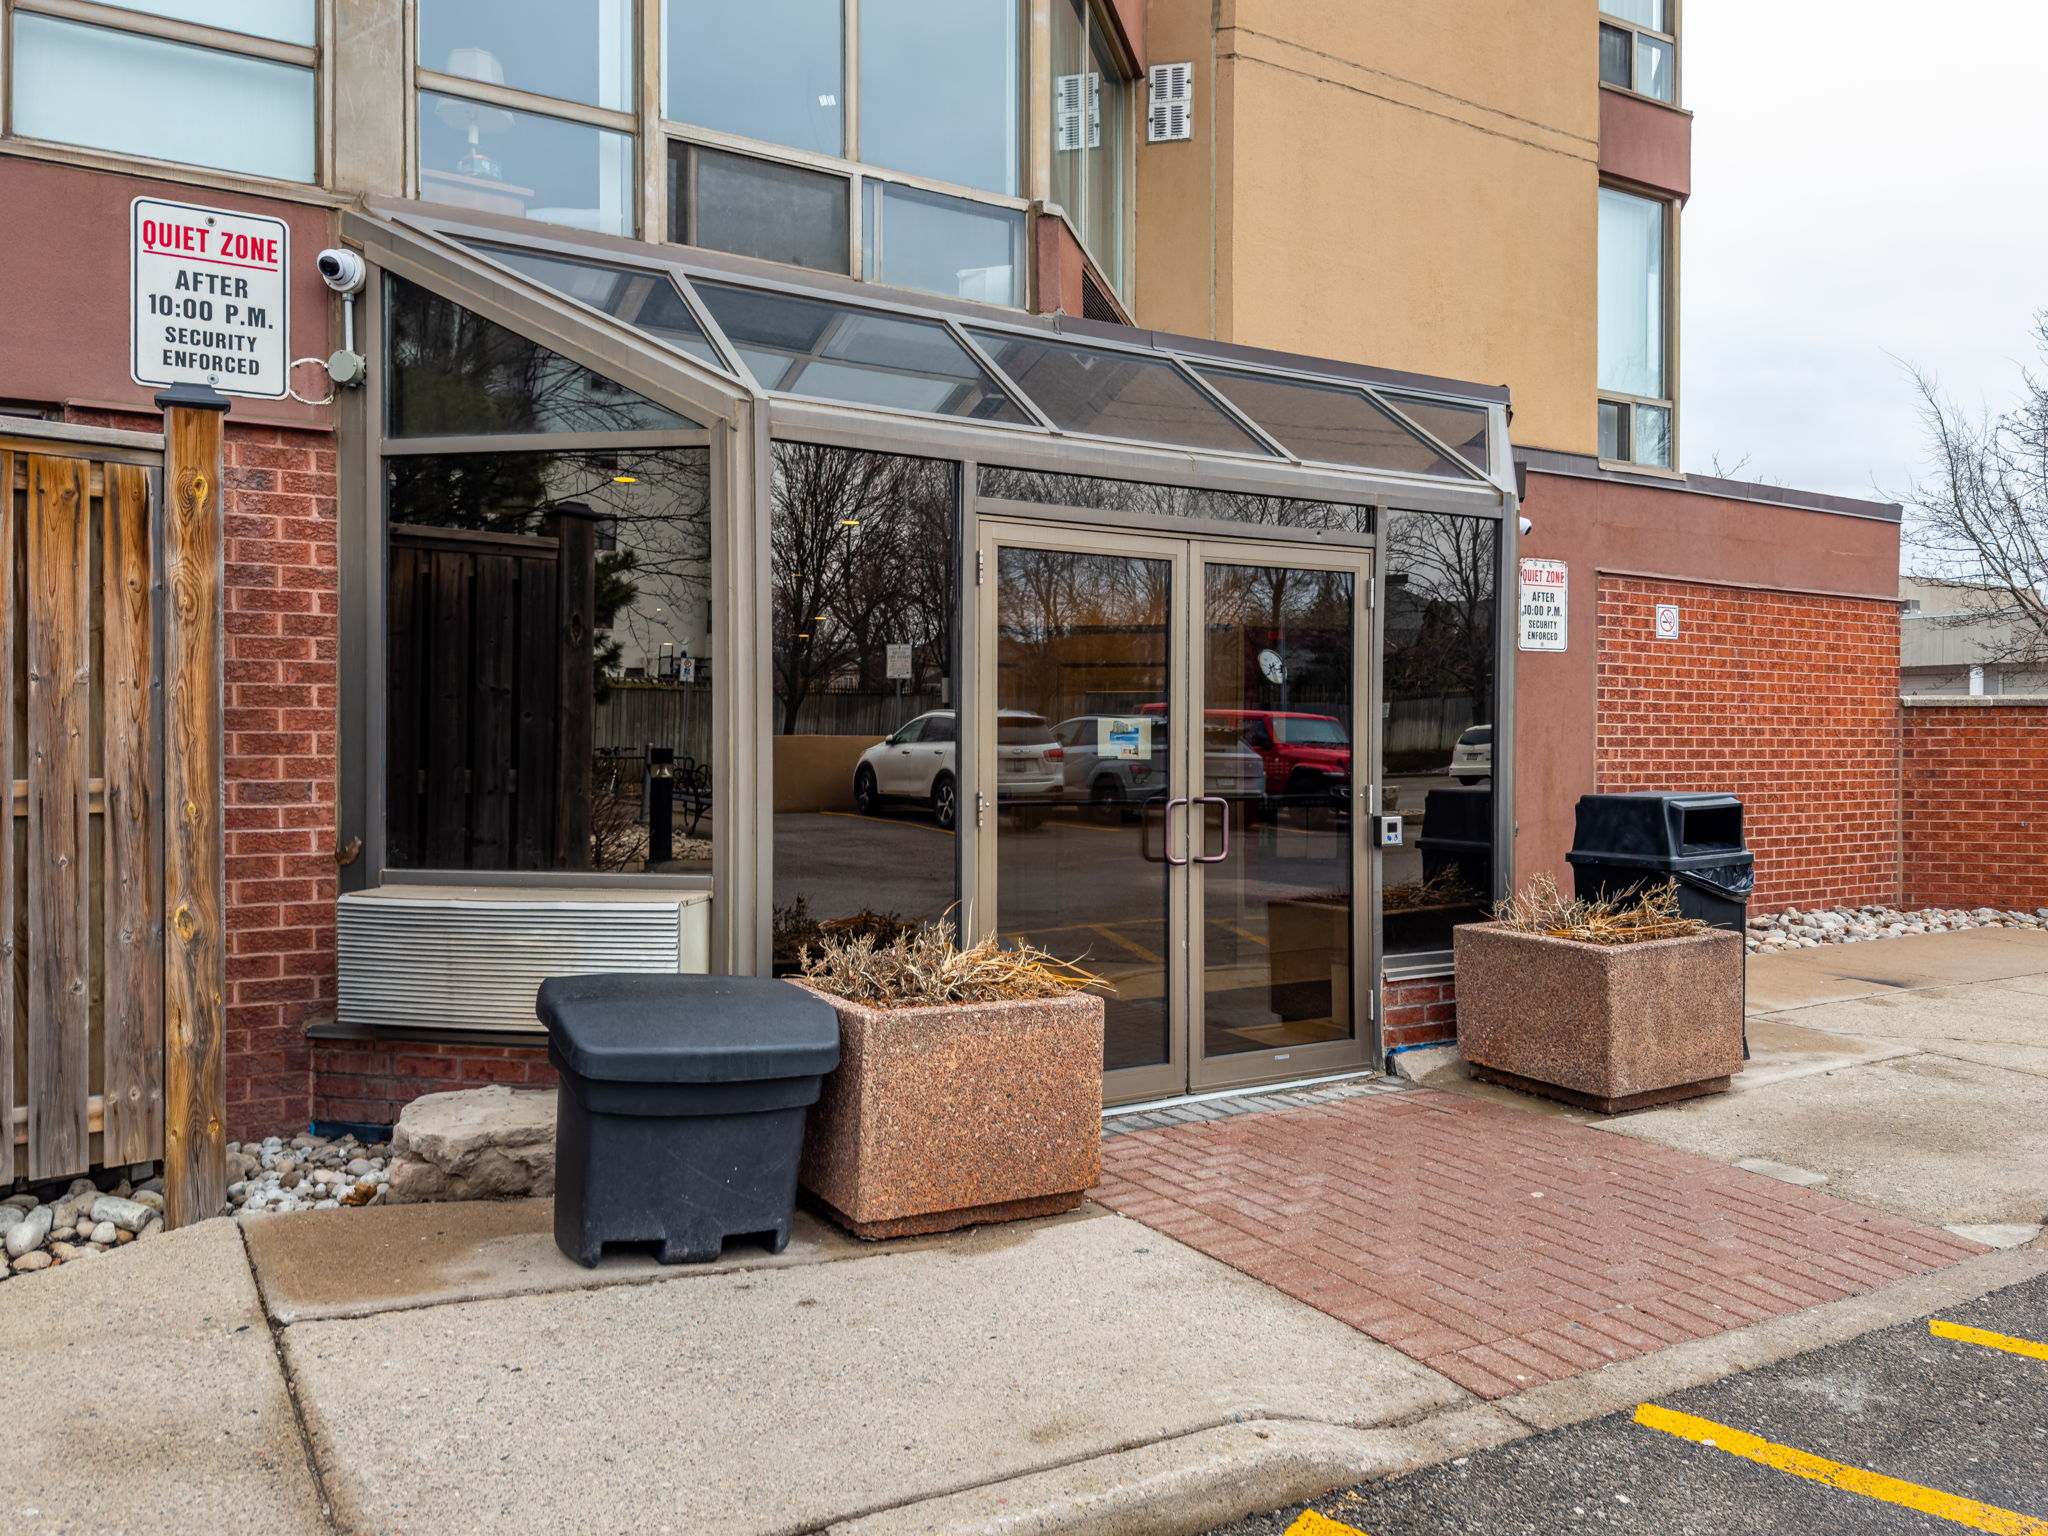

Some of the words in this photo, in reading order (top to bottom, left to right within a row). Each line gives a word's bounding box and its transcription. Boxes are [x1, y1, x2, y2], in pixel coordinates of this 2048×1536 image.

[143, 219, 210, 253] QUIET
[220, 231, 278, 264] ZONE
[175, 270, 248, 299] AFTER
[148, 294, 213, 322] 10:00
[225, 304, 273, 330] P.M.
[165, 326, 257, 352] SECURITY
[163, 349, 260, 376] ENFORCED
[1522, 569, 1543, 583] QUIET
[1546, 570, 1564, 584] ZONE
[1532, 592, 1554, 602] AFTER
[1524, 605, 1543, 616] 10:00
[1547, 606, 1562, 616] P.M.
[1529, 620, 1557, 629] SECURITY
[1528, 631, 1557, 640] ENFORCED
